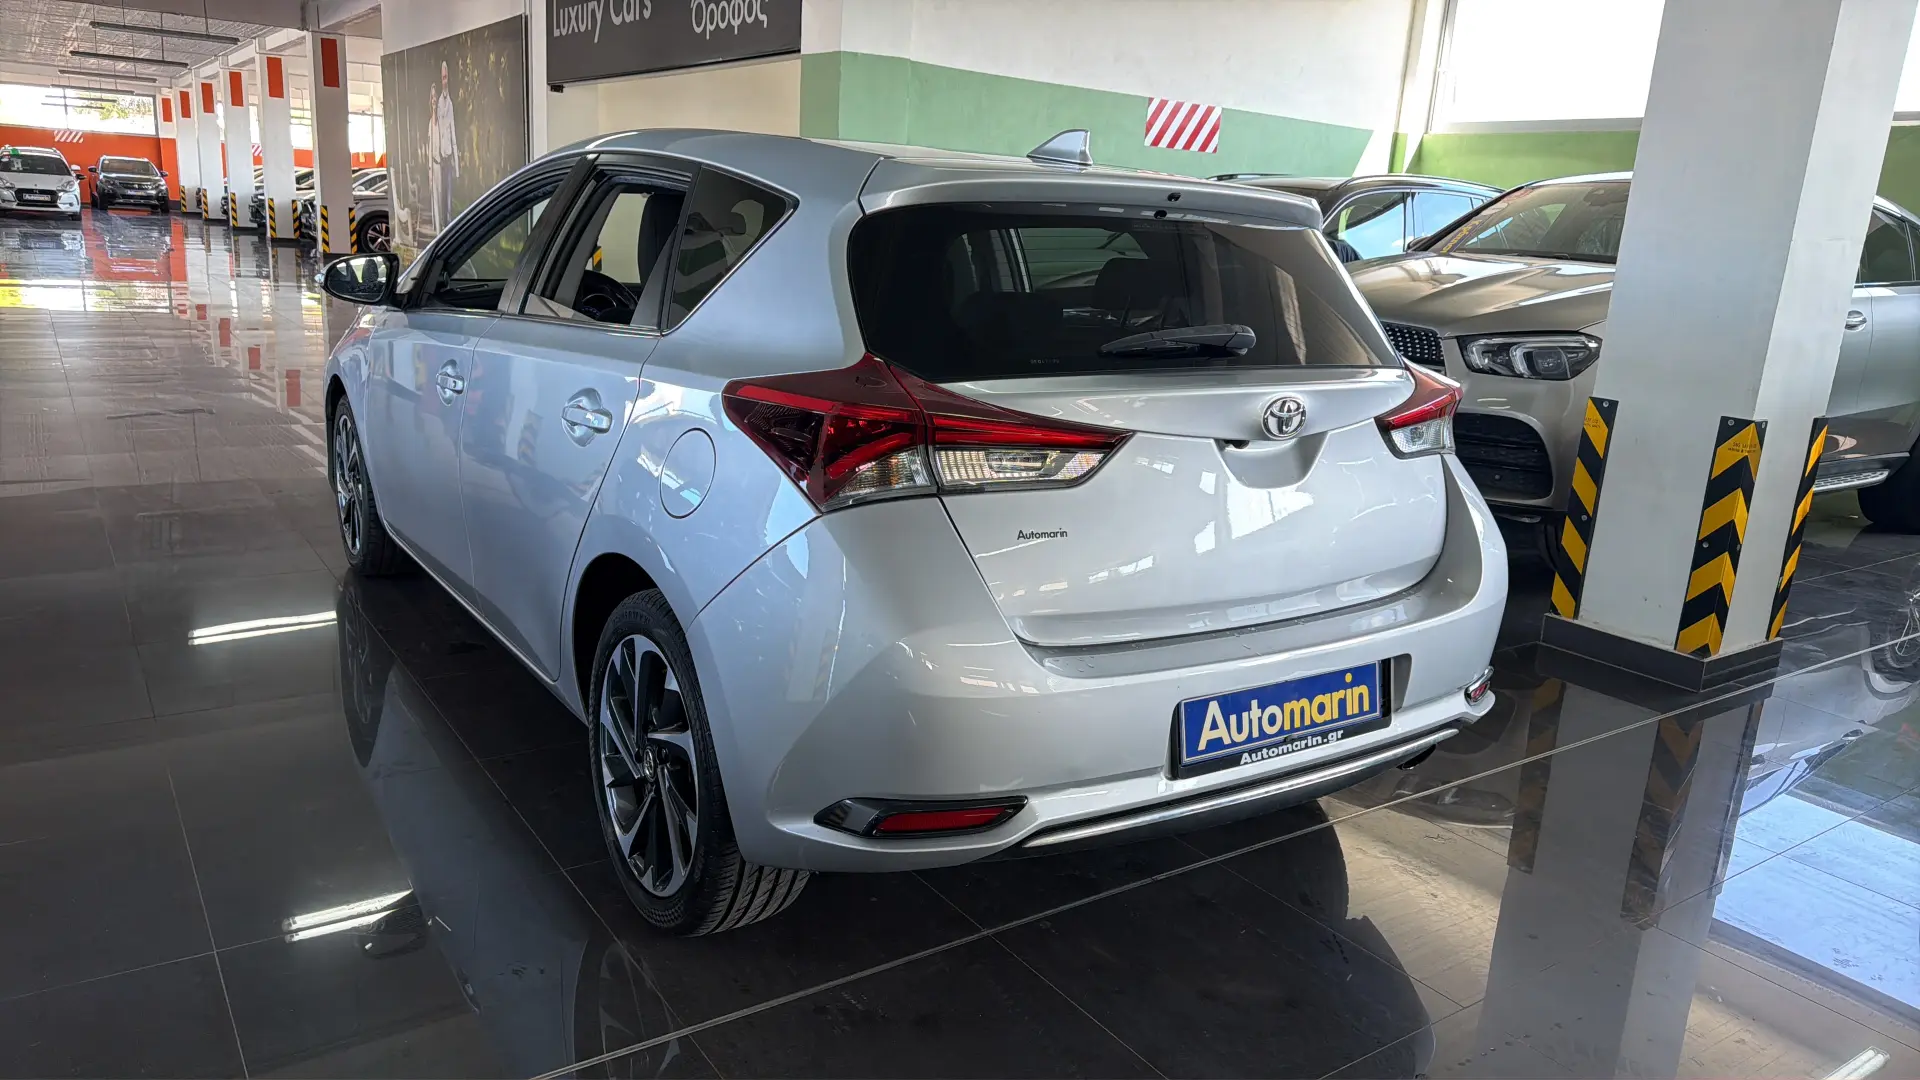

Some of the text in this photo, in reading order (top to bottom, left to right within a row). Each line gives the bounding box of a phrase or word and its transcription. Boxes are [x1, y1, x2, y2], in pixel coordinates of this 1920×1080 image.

[553, 0, 652, 43] Luxury Cars
[1016, 527, 1068, 541] Automarin
[1197, 672, 1370, 751] Automarin
[1239, 729, 1344, 765] Automarin.gr
